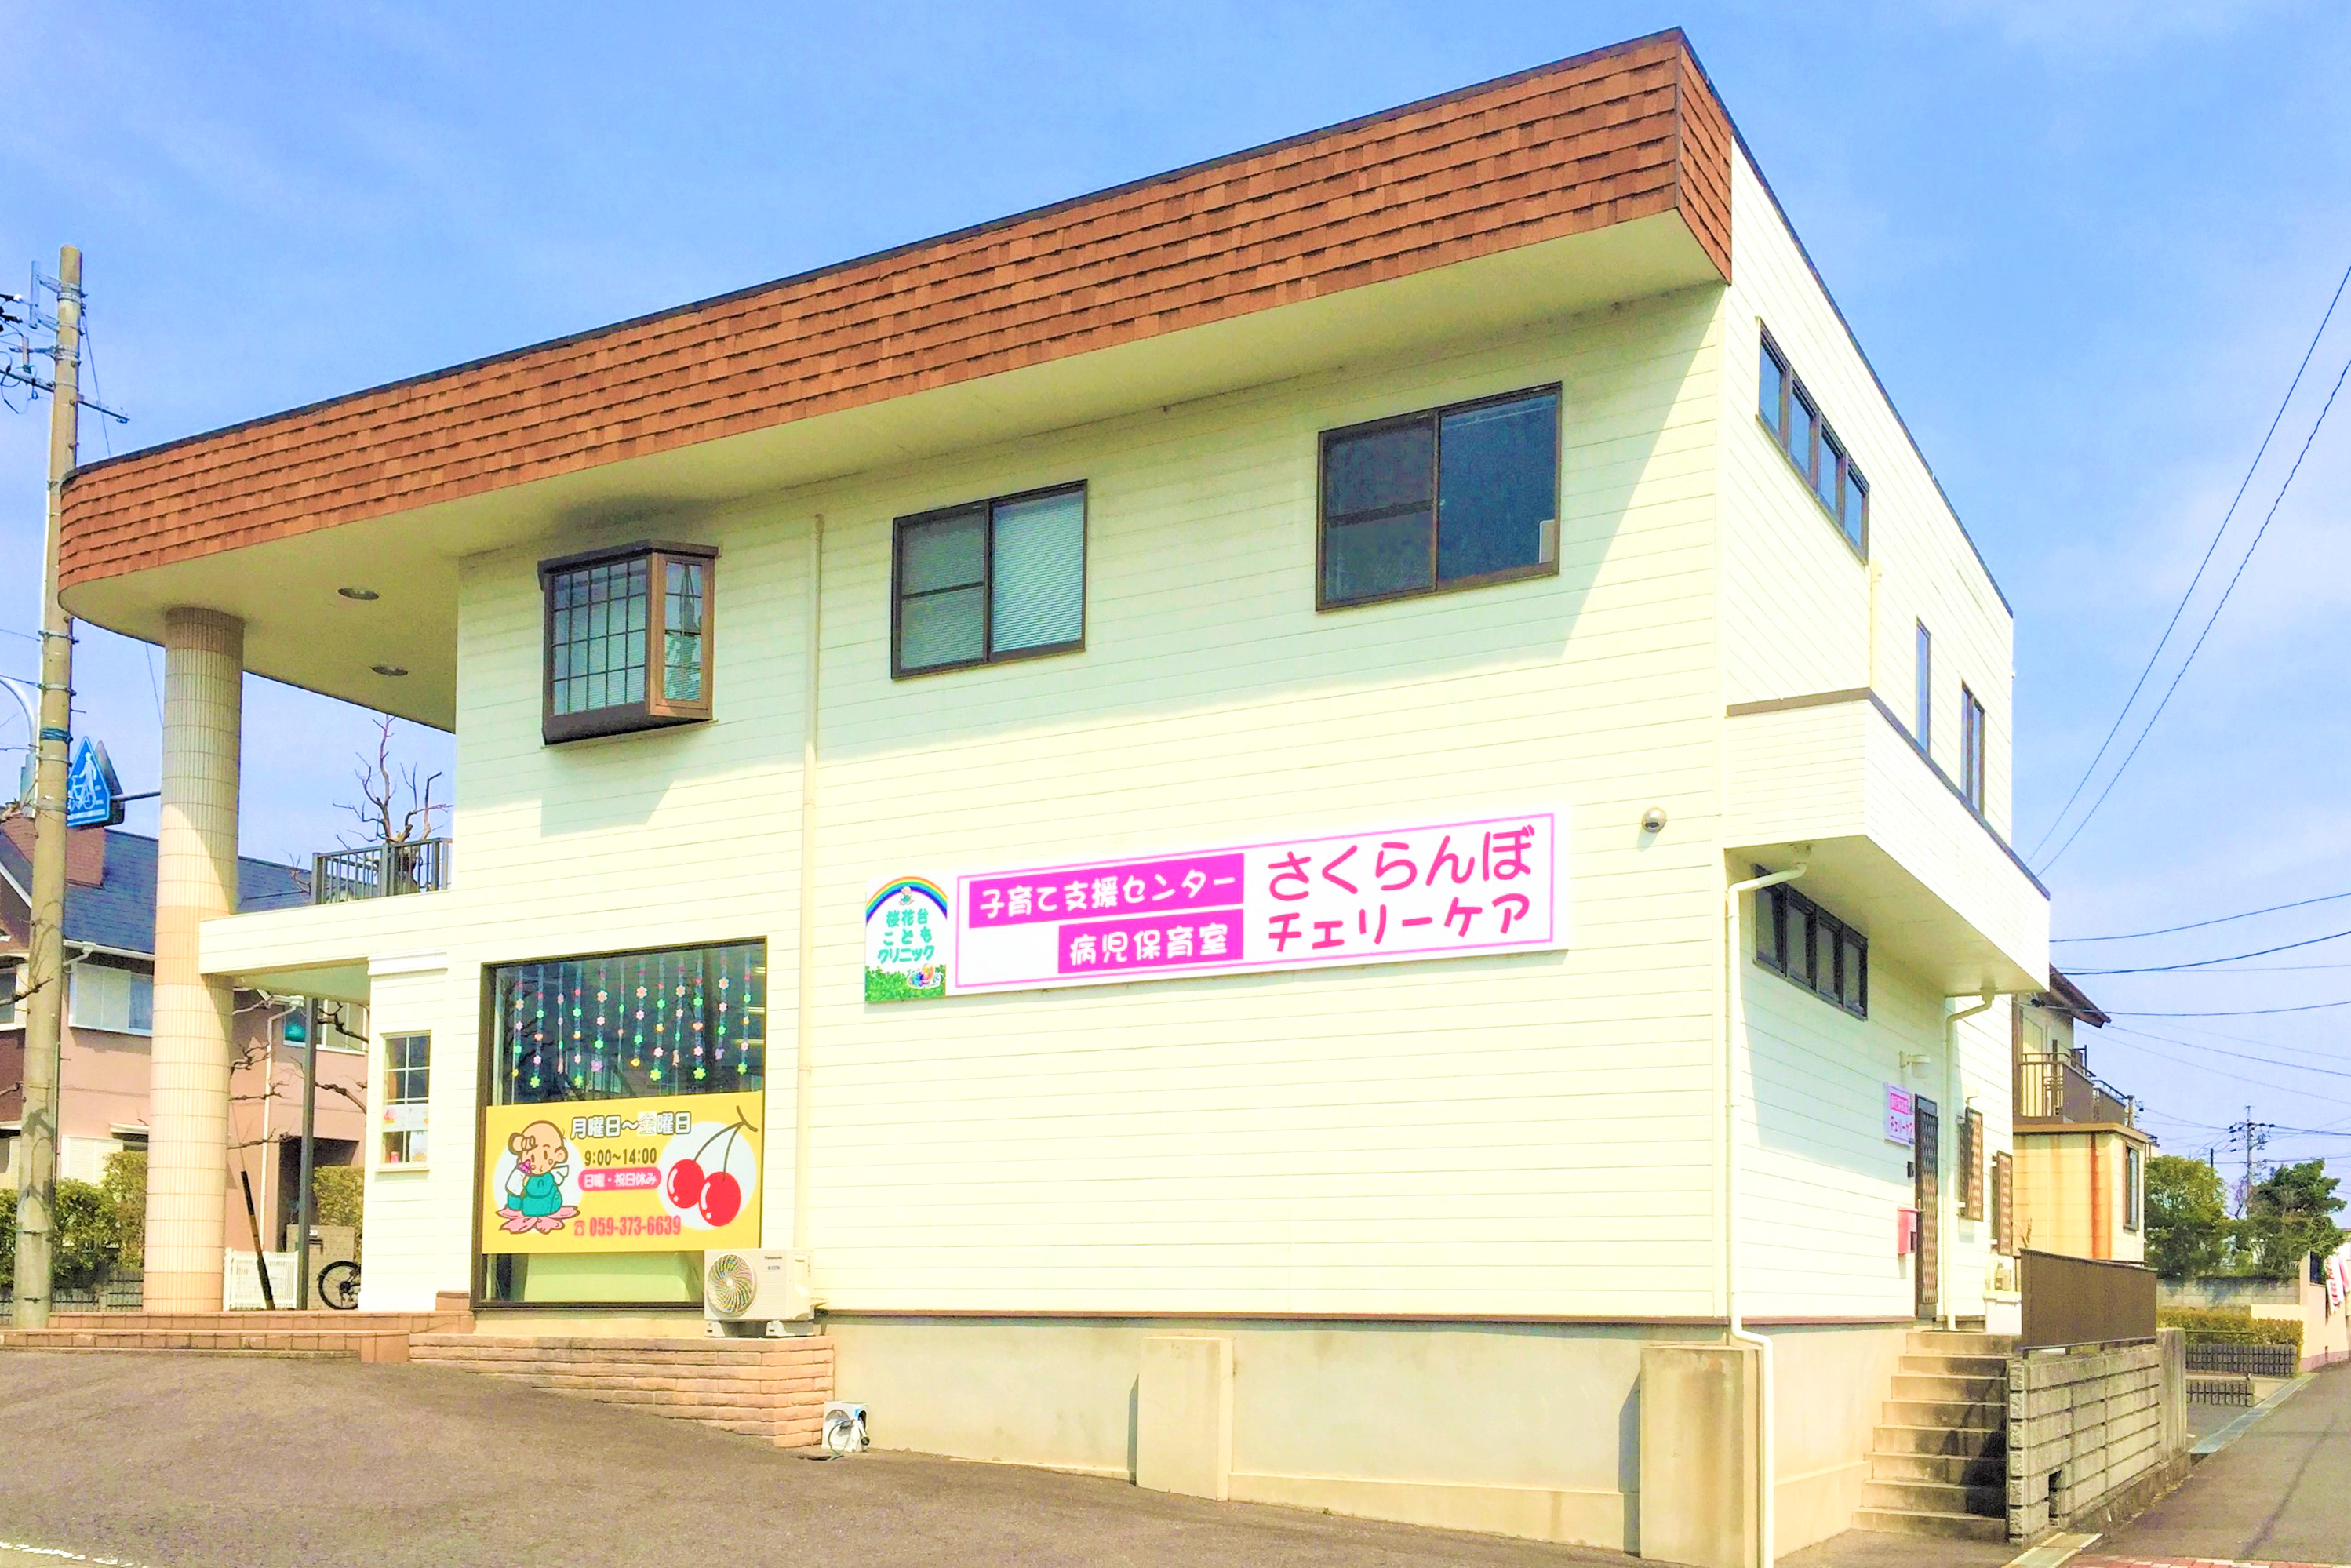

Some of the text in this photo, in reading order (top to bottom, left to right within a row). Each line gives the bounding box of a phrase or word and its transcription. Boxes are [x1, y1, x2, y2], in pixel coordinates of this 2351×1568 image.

[1268, 824, 1535, 901] さくらんぼ
[980, 868, 1236, 919] 子育て支援センター
[886, 908, 929, 928] 桜花台
[1268, 893, 1530, 952] チェリーケア
[883, 926, 932, 946] こども
[1069, 922, 1228, 966] 病児保育室
[877, 945, 935, 964] クリニック
[589, 1215, 681, 1237] 059-373-6639
